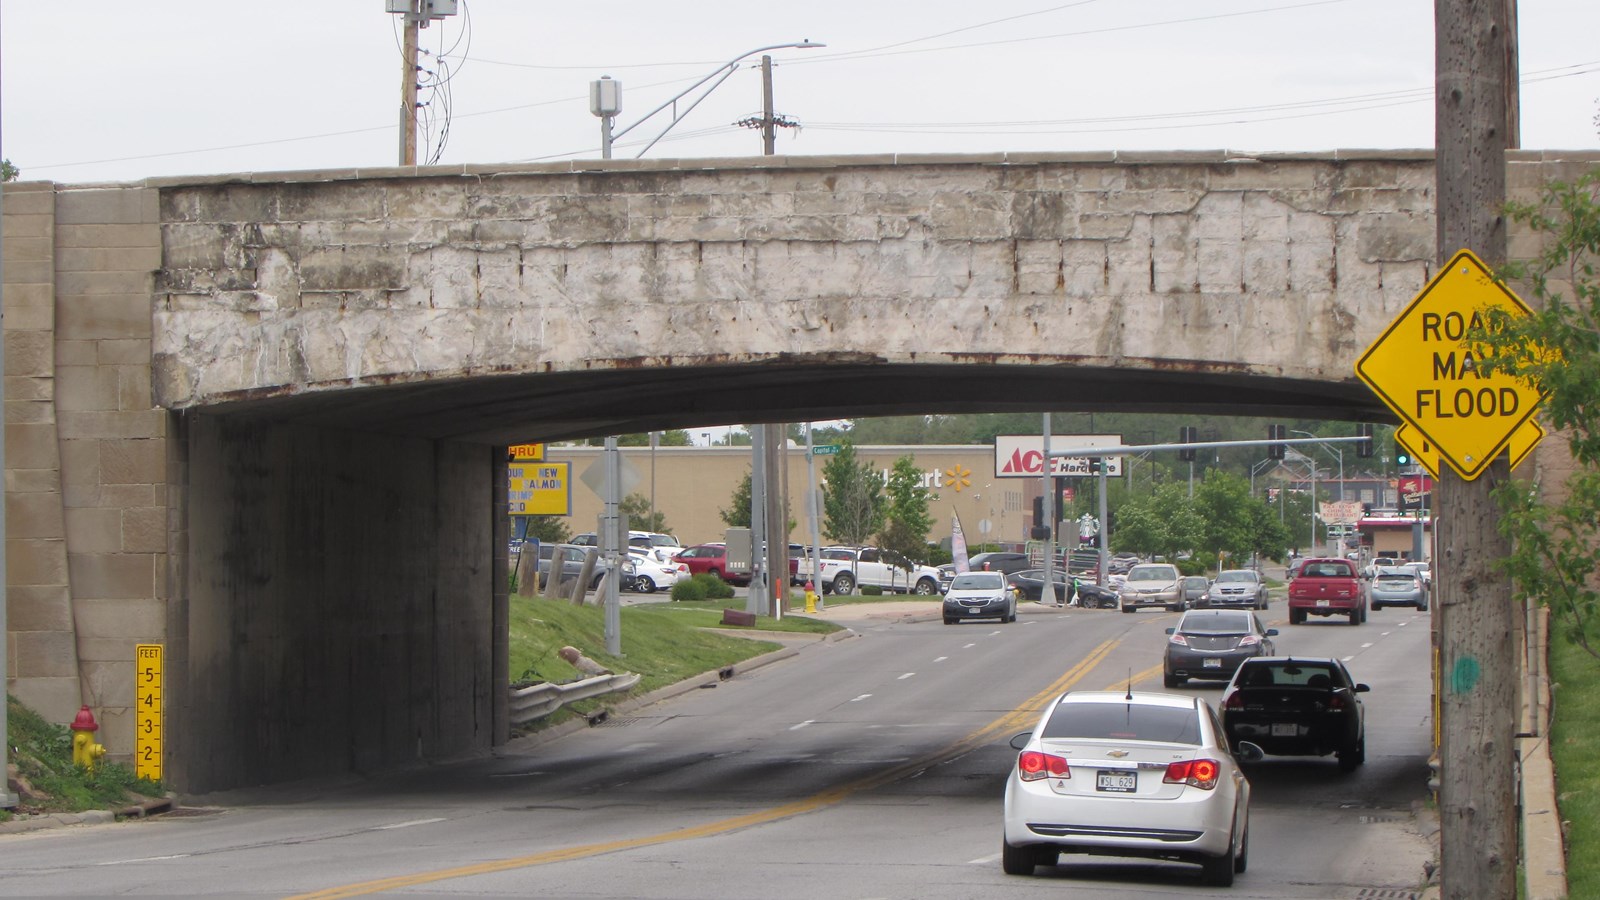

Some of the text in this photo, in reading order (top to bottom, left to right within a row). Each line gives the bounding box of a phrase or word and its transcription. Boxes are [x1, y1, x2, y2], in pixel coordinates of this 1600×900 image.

[1422, 311, 1500, 341] ROA
[1416, 387, 1519, 419] FLOOD
[509, 446, 535, 457] HRU
[1002, 447, 1059, 473] ACE
[538, 468, 558, 478] NEW
[1060, 463, 1116, 473] Hardre
[523, 479, 562, 489] SALMON
[140, 649, 159, 658] FEET
[145, 667, 154, 682] 5
[144, 693, 153, 708] 4
[144, 719, 153, 734] 3
[144, 746, 153, 760] 2
[1100, 776, 1133, 787] WSL 629
